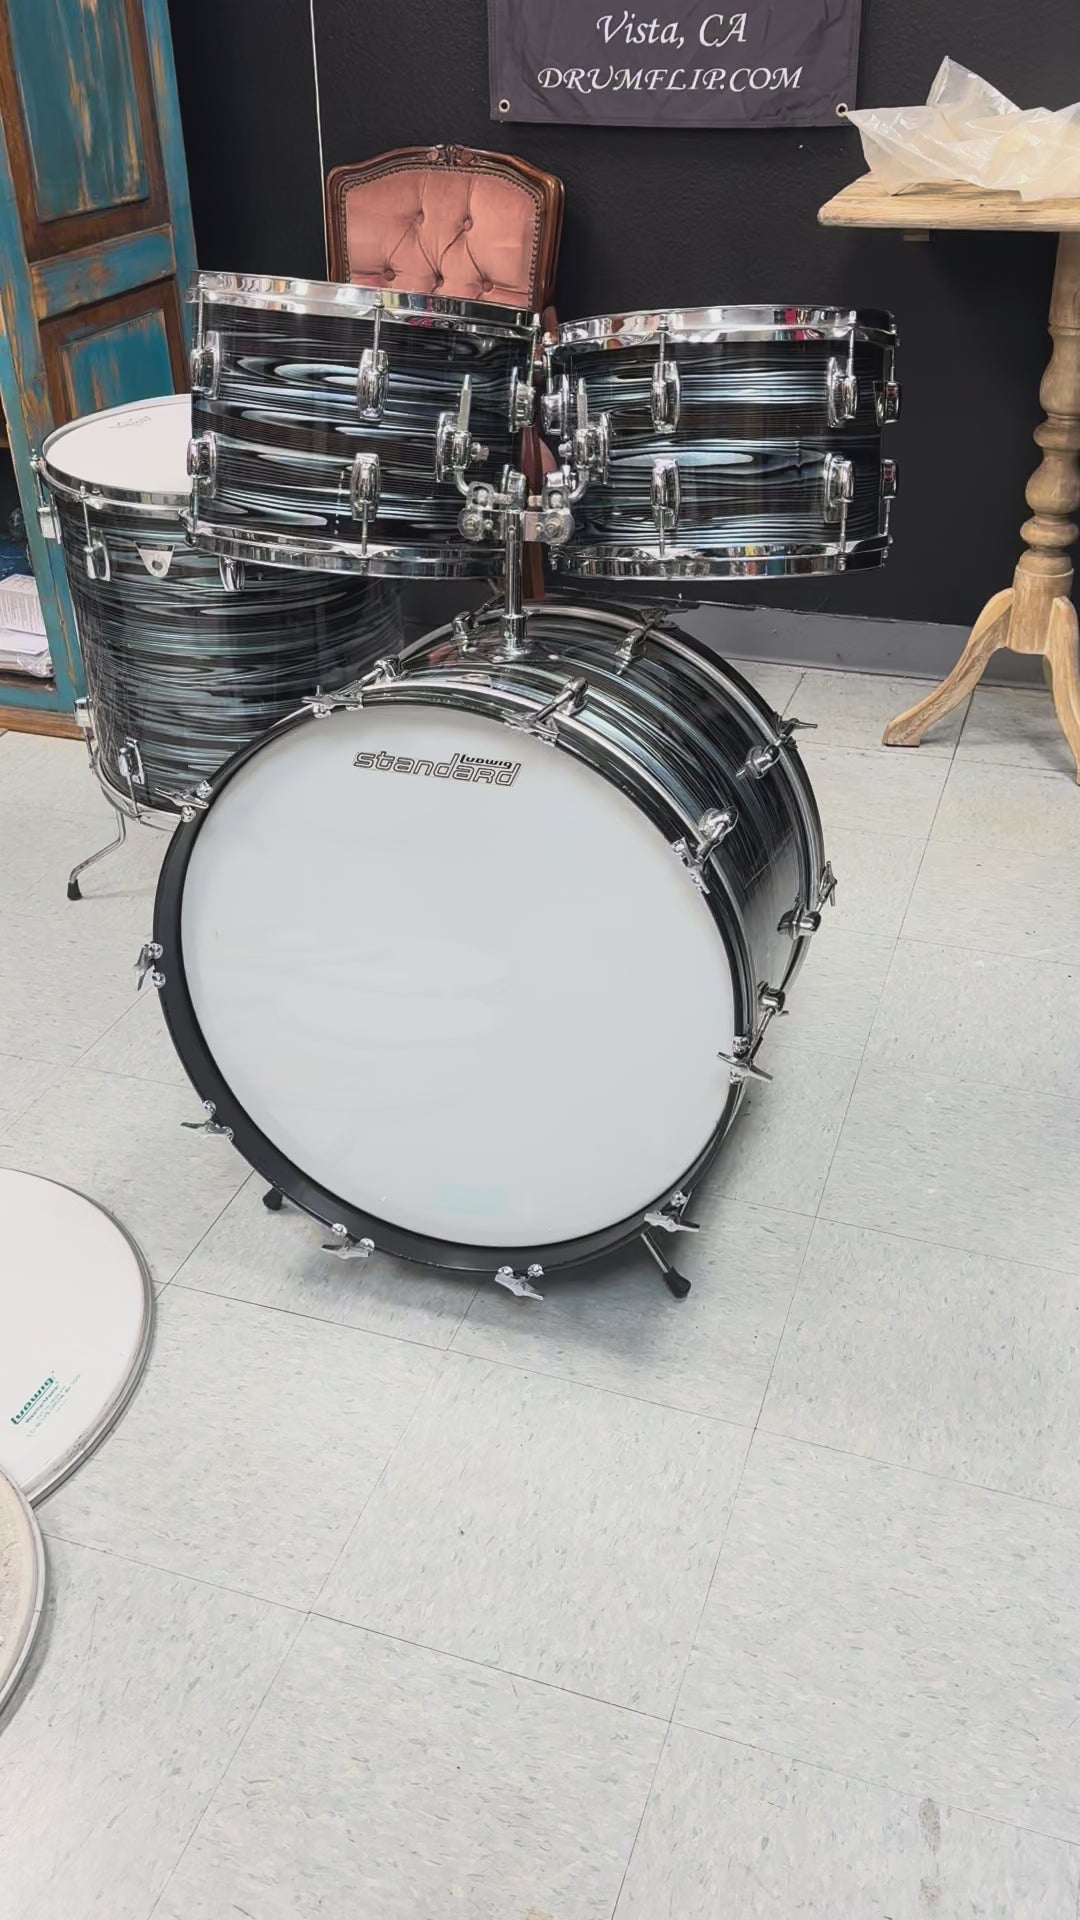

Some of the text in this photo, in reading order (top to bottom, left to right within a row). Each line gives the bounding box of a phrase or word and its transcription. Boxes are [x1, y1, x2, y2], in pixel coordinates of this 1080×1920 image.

[596, 10, 748, 49] Vista, CA
[537, 66, 804, 94] DRUMFLIP.COM
